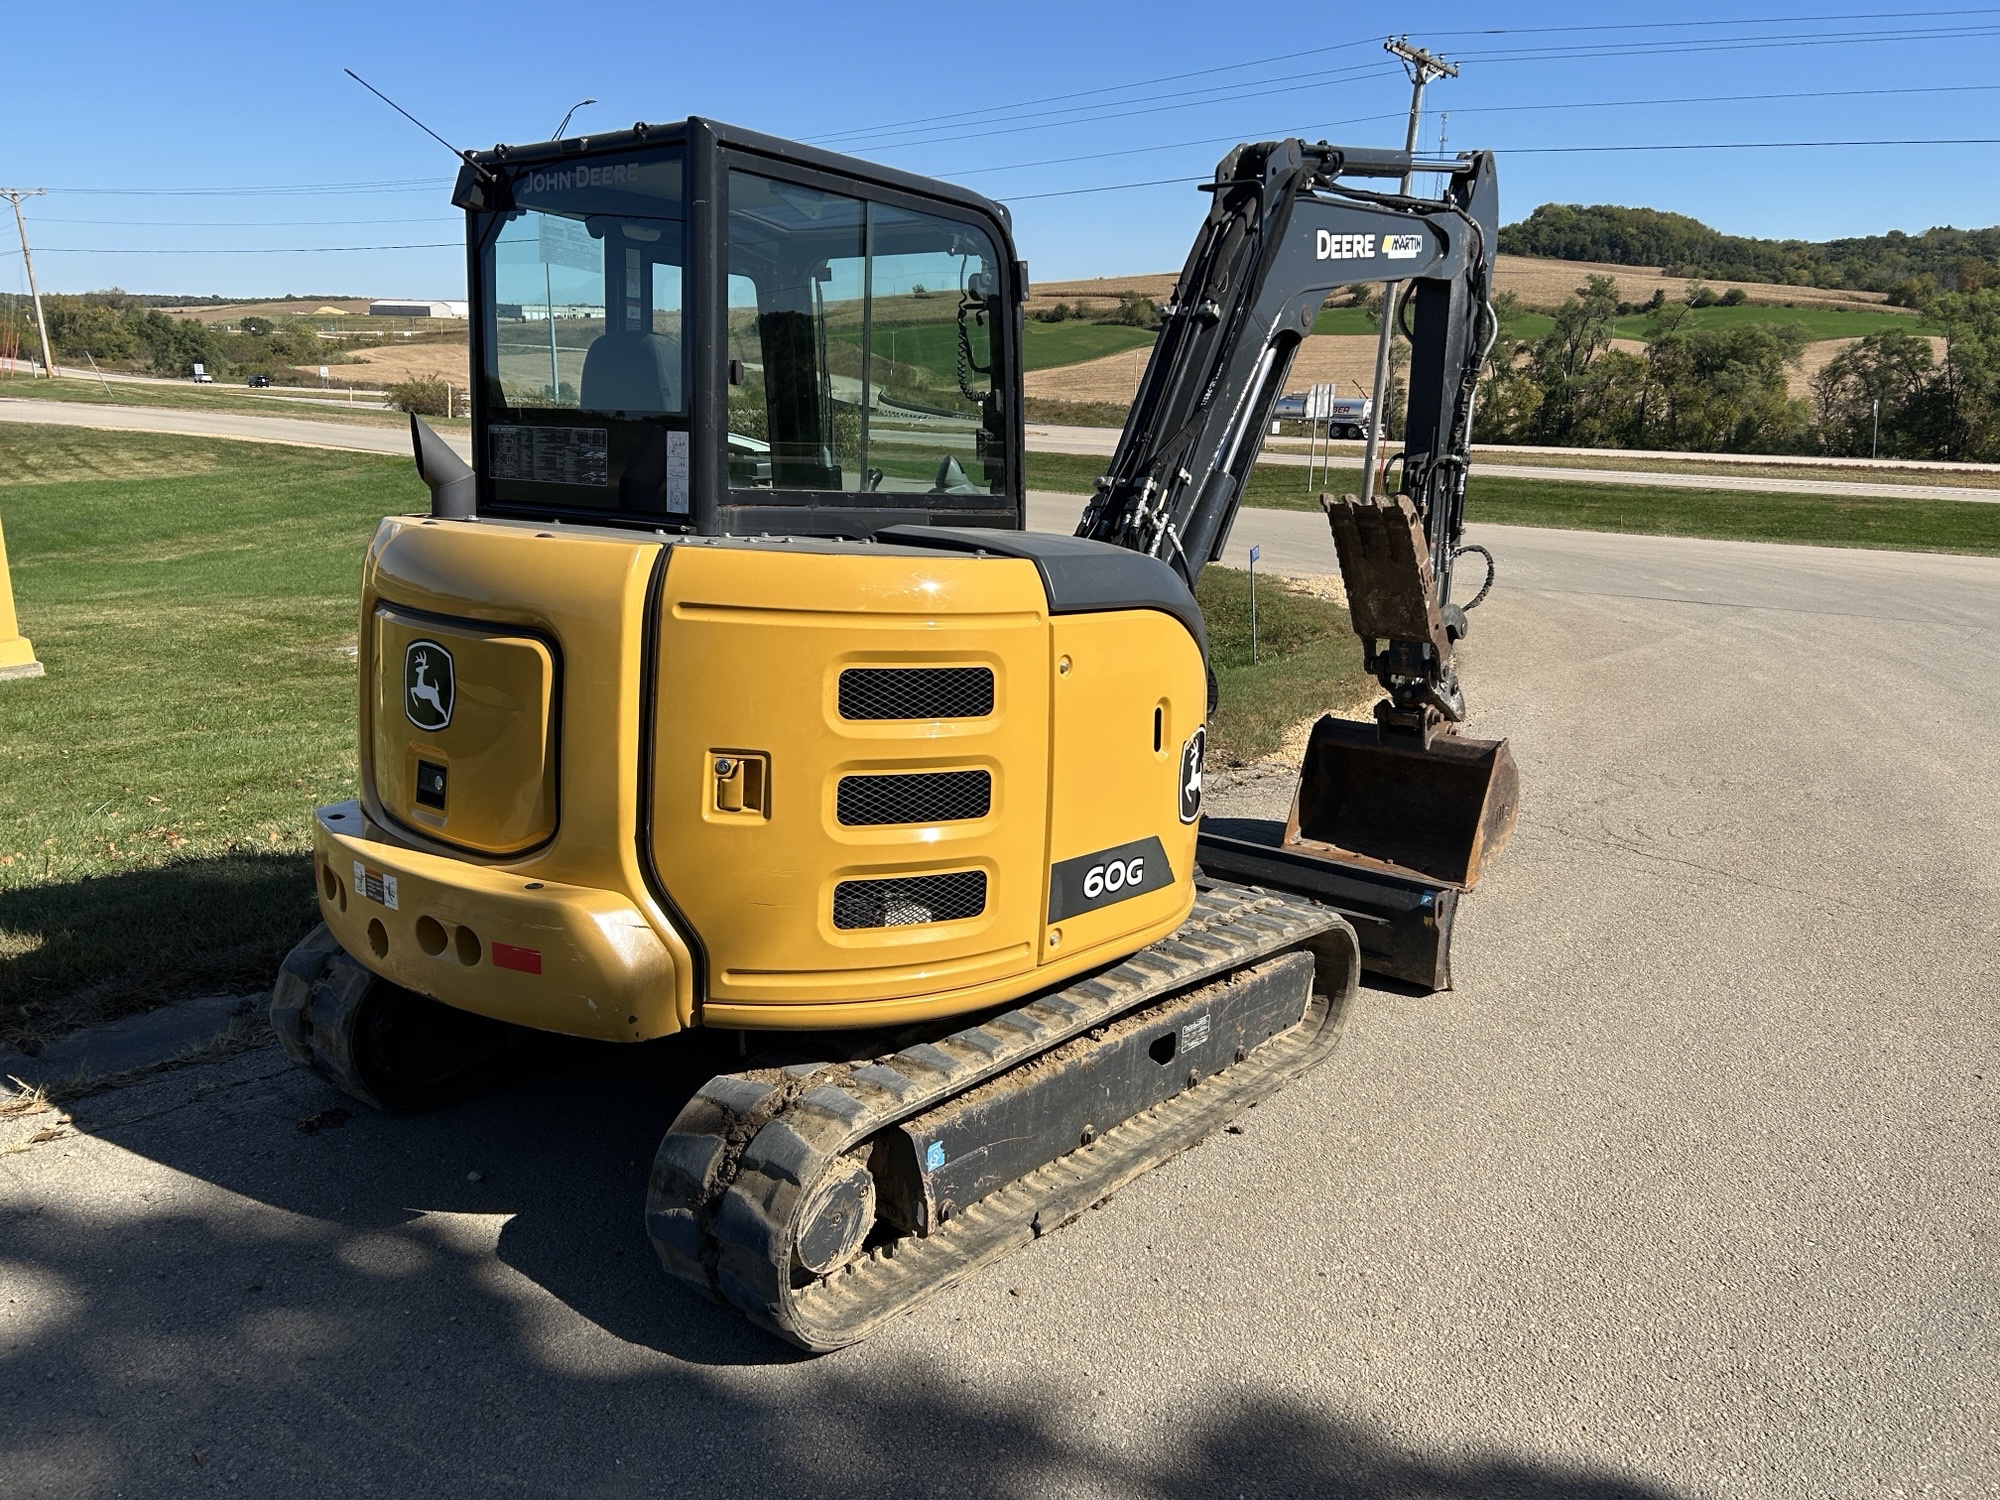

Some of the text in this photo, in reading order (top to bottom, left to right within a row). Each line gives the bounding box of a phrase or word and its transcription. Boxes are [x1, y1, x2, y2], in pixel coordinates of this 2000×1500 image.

[525, 163, 639, 194] JOHN DEERE
[1316, 229, 1376, 260] DEERE
[1391, 236, 1422, 251] MARTIN
[1083, 857, 1145, 900] 60G
